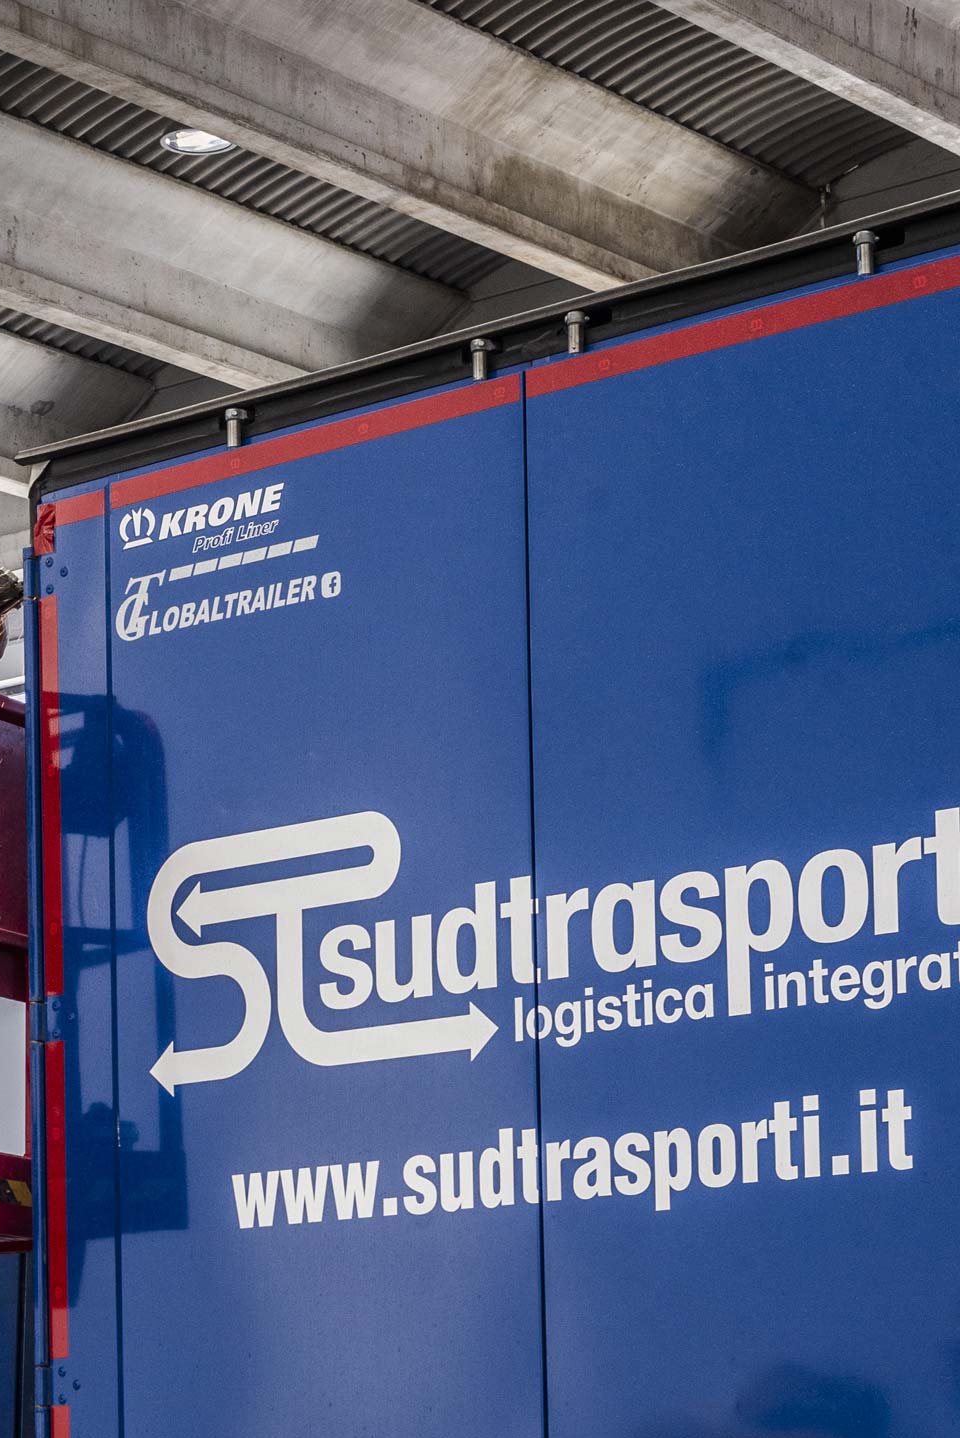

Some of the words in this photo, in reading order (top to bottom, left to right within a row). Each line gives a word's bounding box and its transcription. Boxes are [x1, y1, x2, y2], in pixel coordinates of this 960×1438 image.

[158, 482, 285, 540] KRONE
[192, 530, 233, 553] Profi
[235, 519, 280, 542] Liner
[514, 982, 715, 1047] logistica
[763, 940, 960, 1012] integra
[231, 1088, 915, 1229] www.sudtrasporti.it
